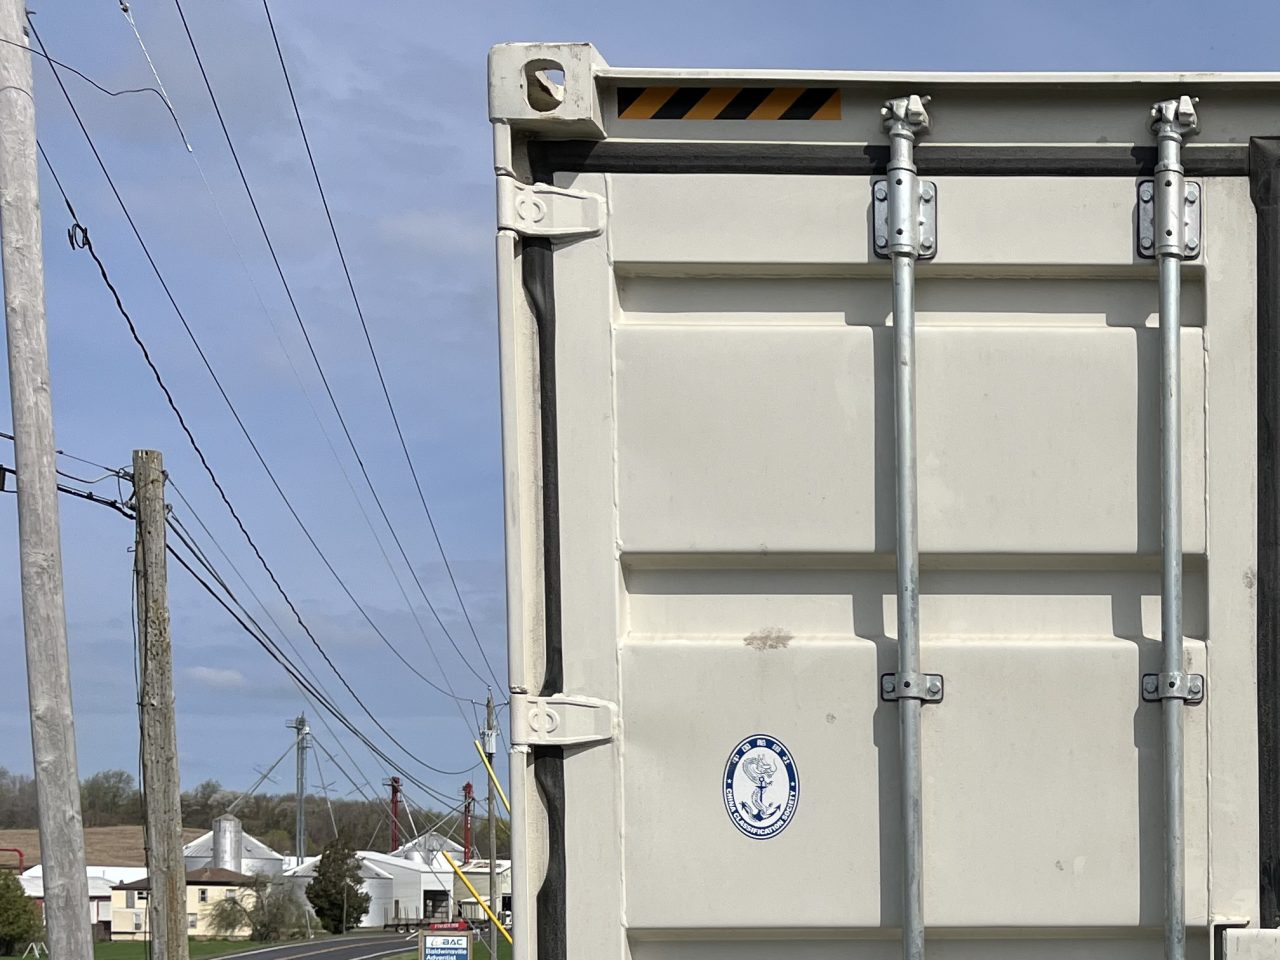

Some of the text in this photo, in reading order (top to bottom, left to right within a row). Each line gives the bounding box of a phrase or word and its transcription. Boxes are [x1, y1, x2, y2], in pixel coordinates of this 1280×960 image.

[726, 788, 796, 835] CHINA CLASSIFICATION SOCIETY
